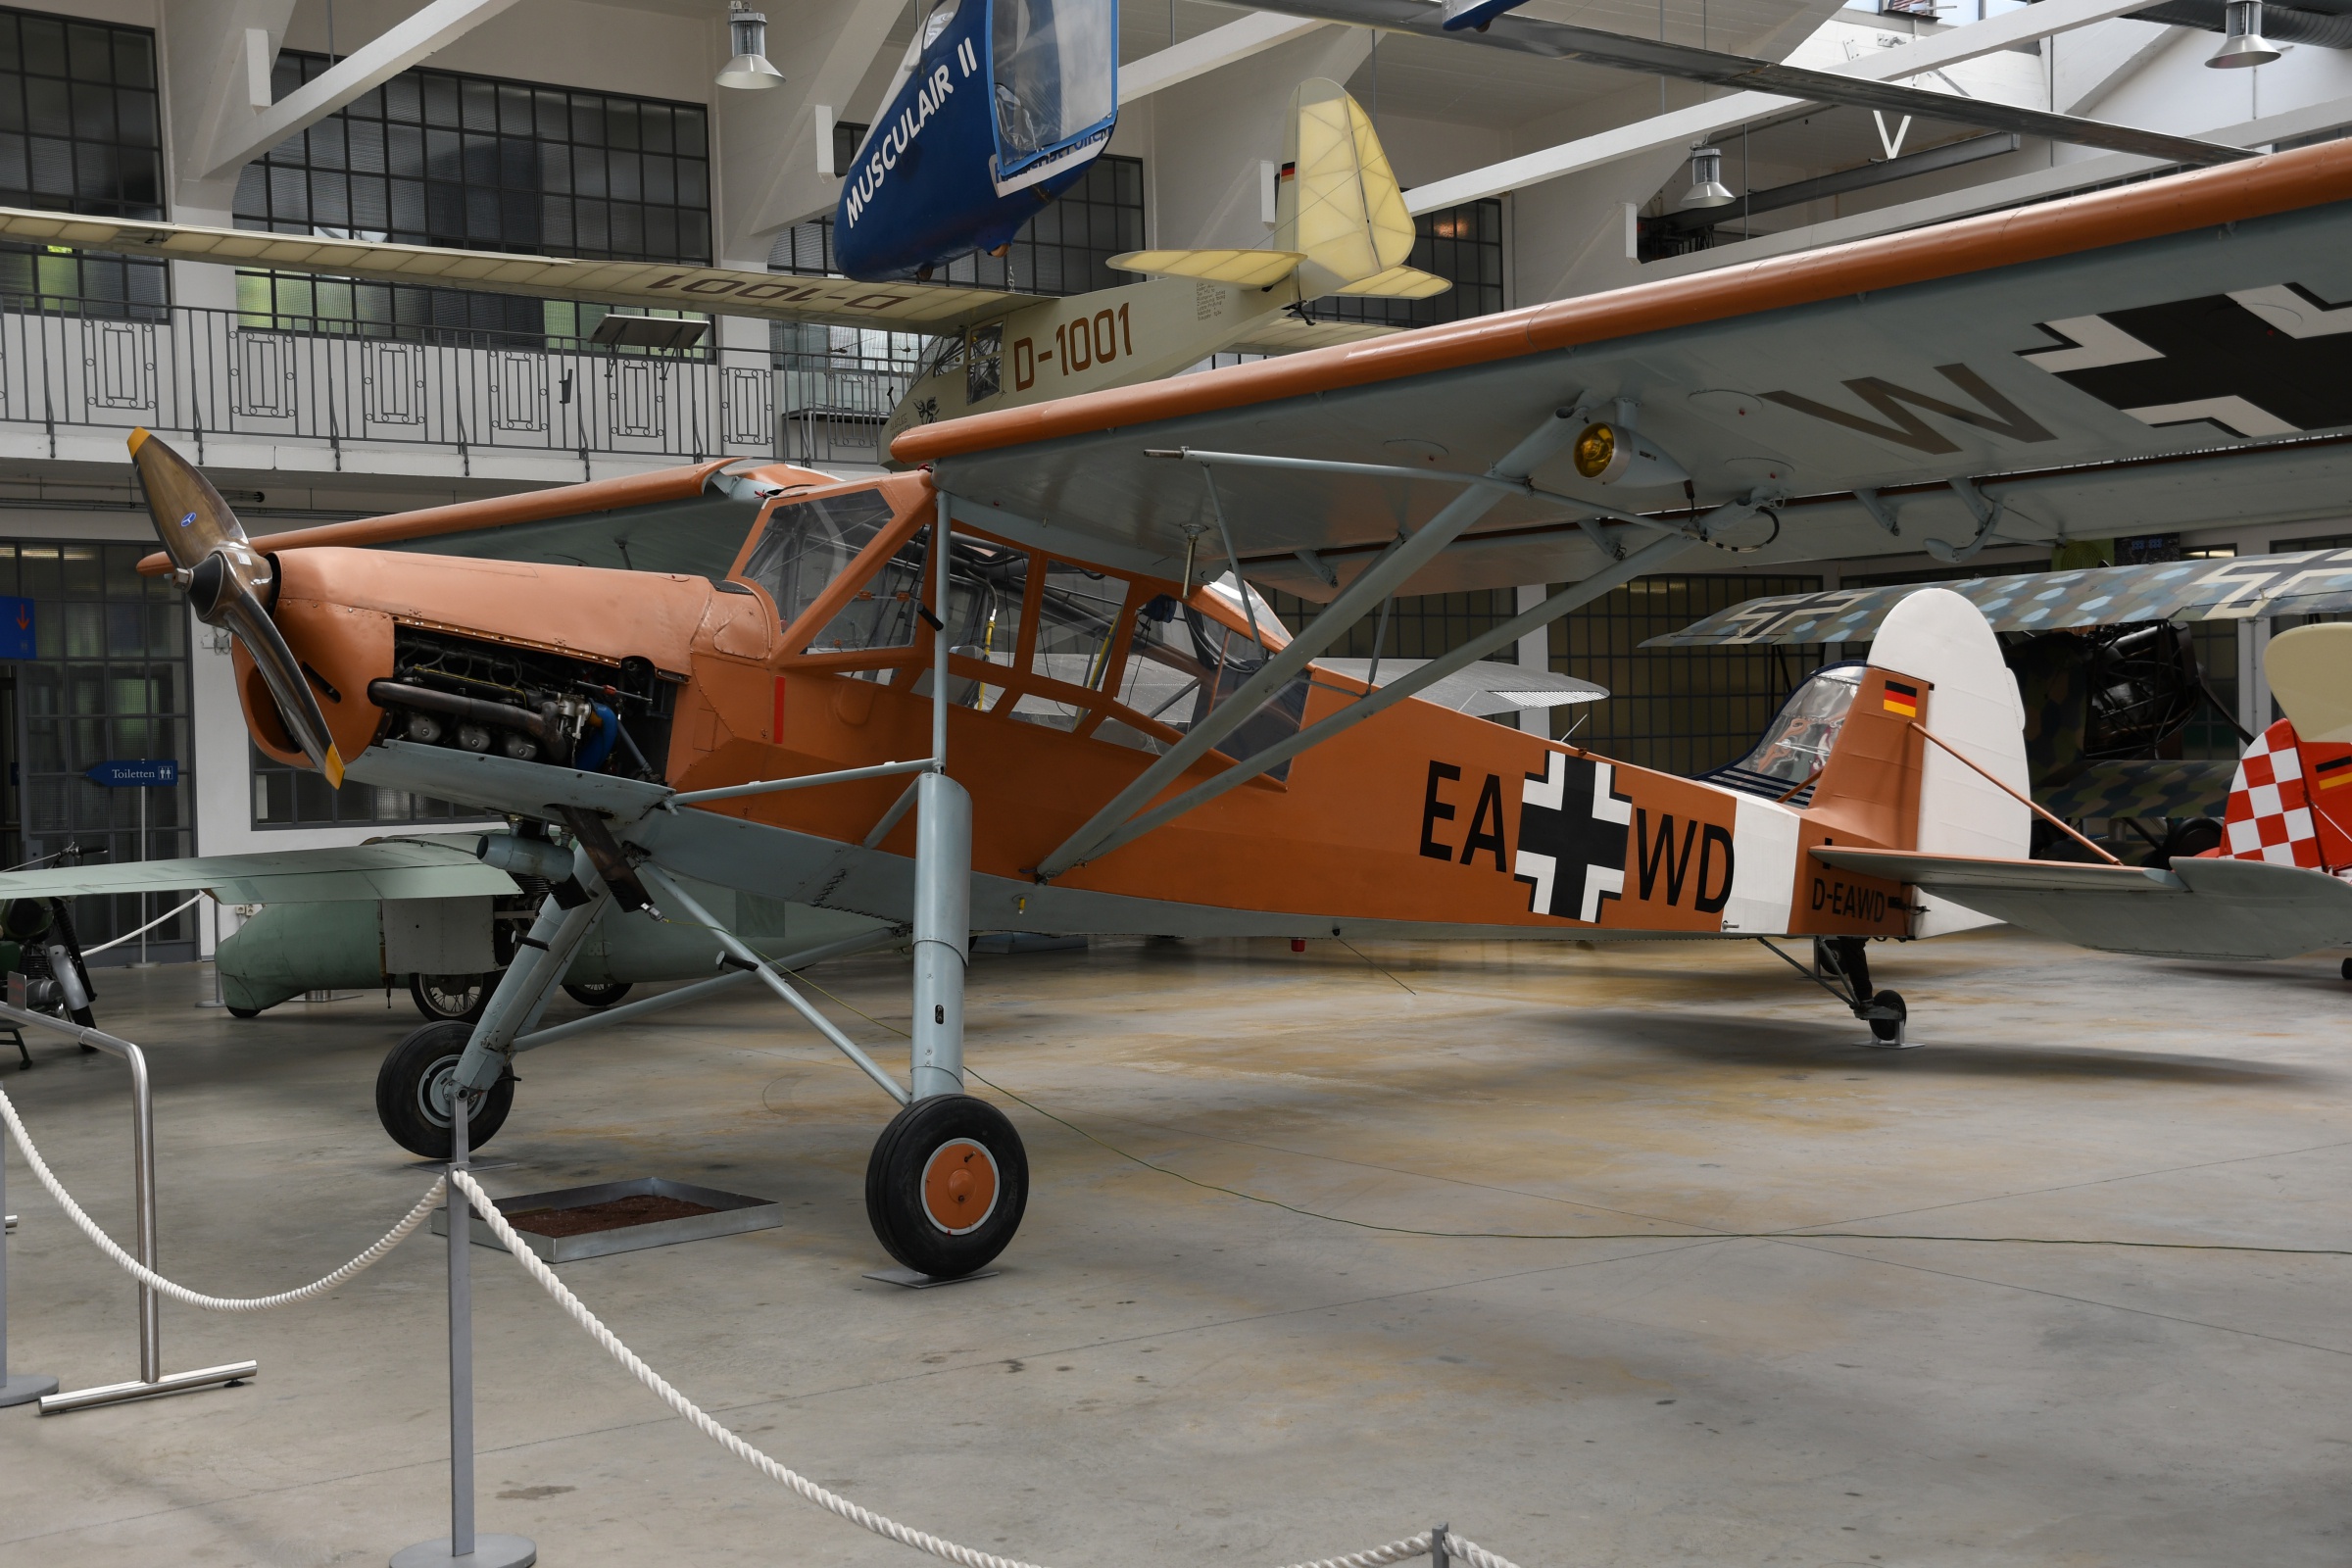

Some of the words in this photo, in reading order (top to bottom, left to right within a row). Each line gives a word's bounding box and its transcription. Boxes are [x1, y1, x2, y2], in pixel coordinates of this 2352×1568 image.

[846, 64, 955, 229] MUSCULAIR
[957, 36, 978, 78] II
[645, 273, 912, 311] D-1001
[1013, 301, 1133, 393] D-1001
[111, 768, 156, 779] Toiletten
[1419, 759, 1508, 874] EA
[1636, 807, 1736, 914] WD
[1811, 877, 1886, 923] D-EAWD
